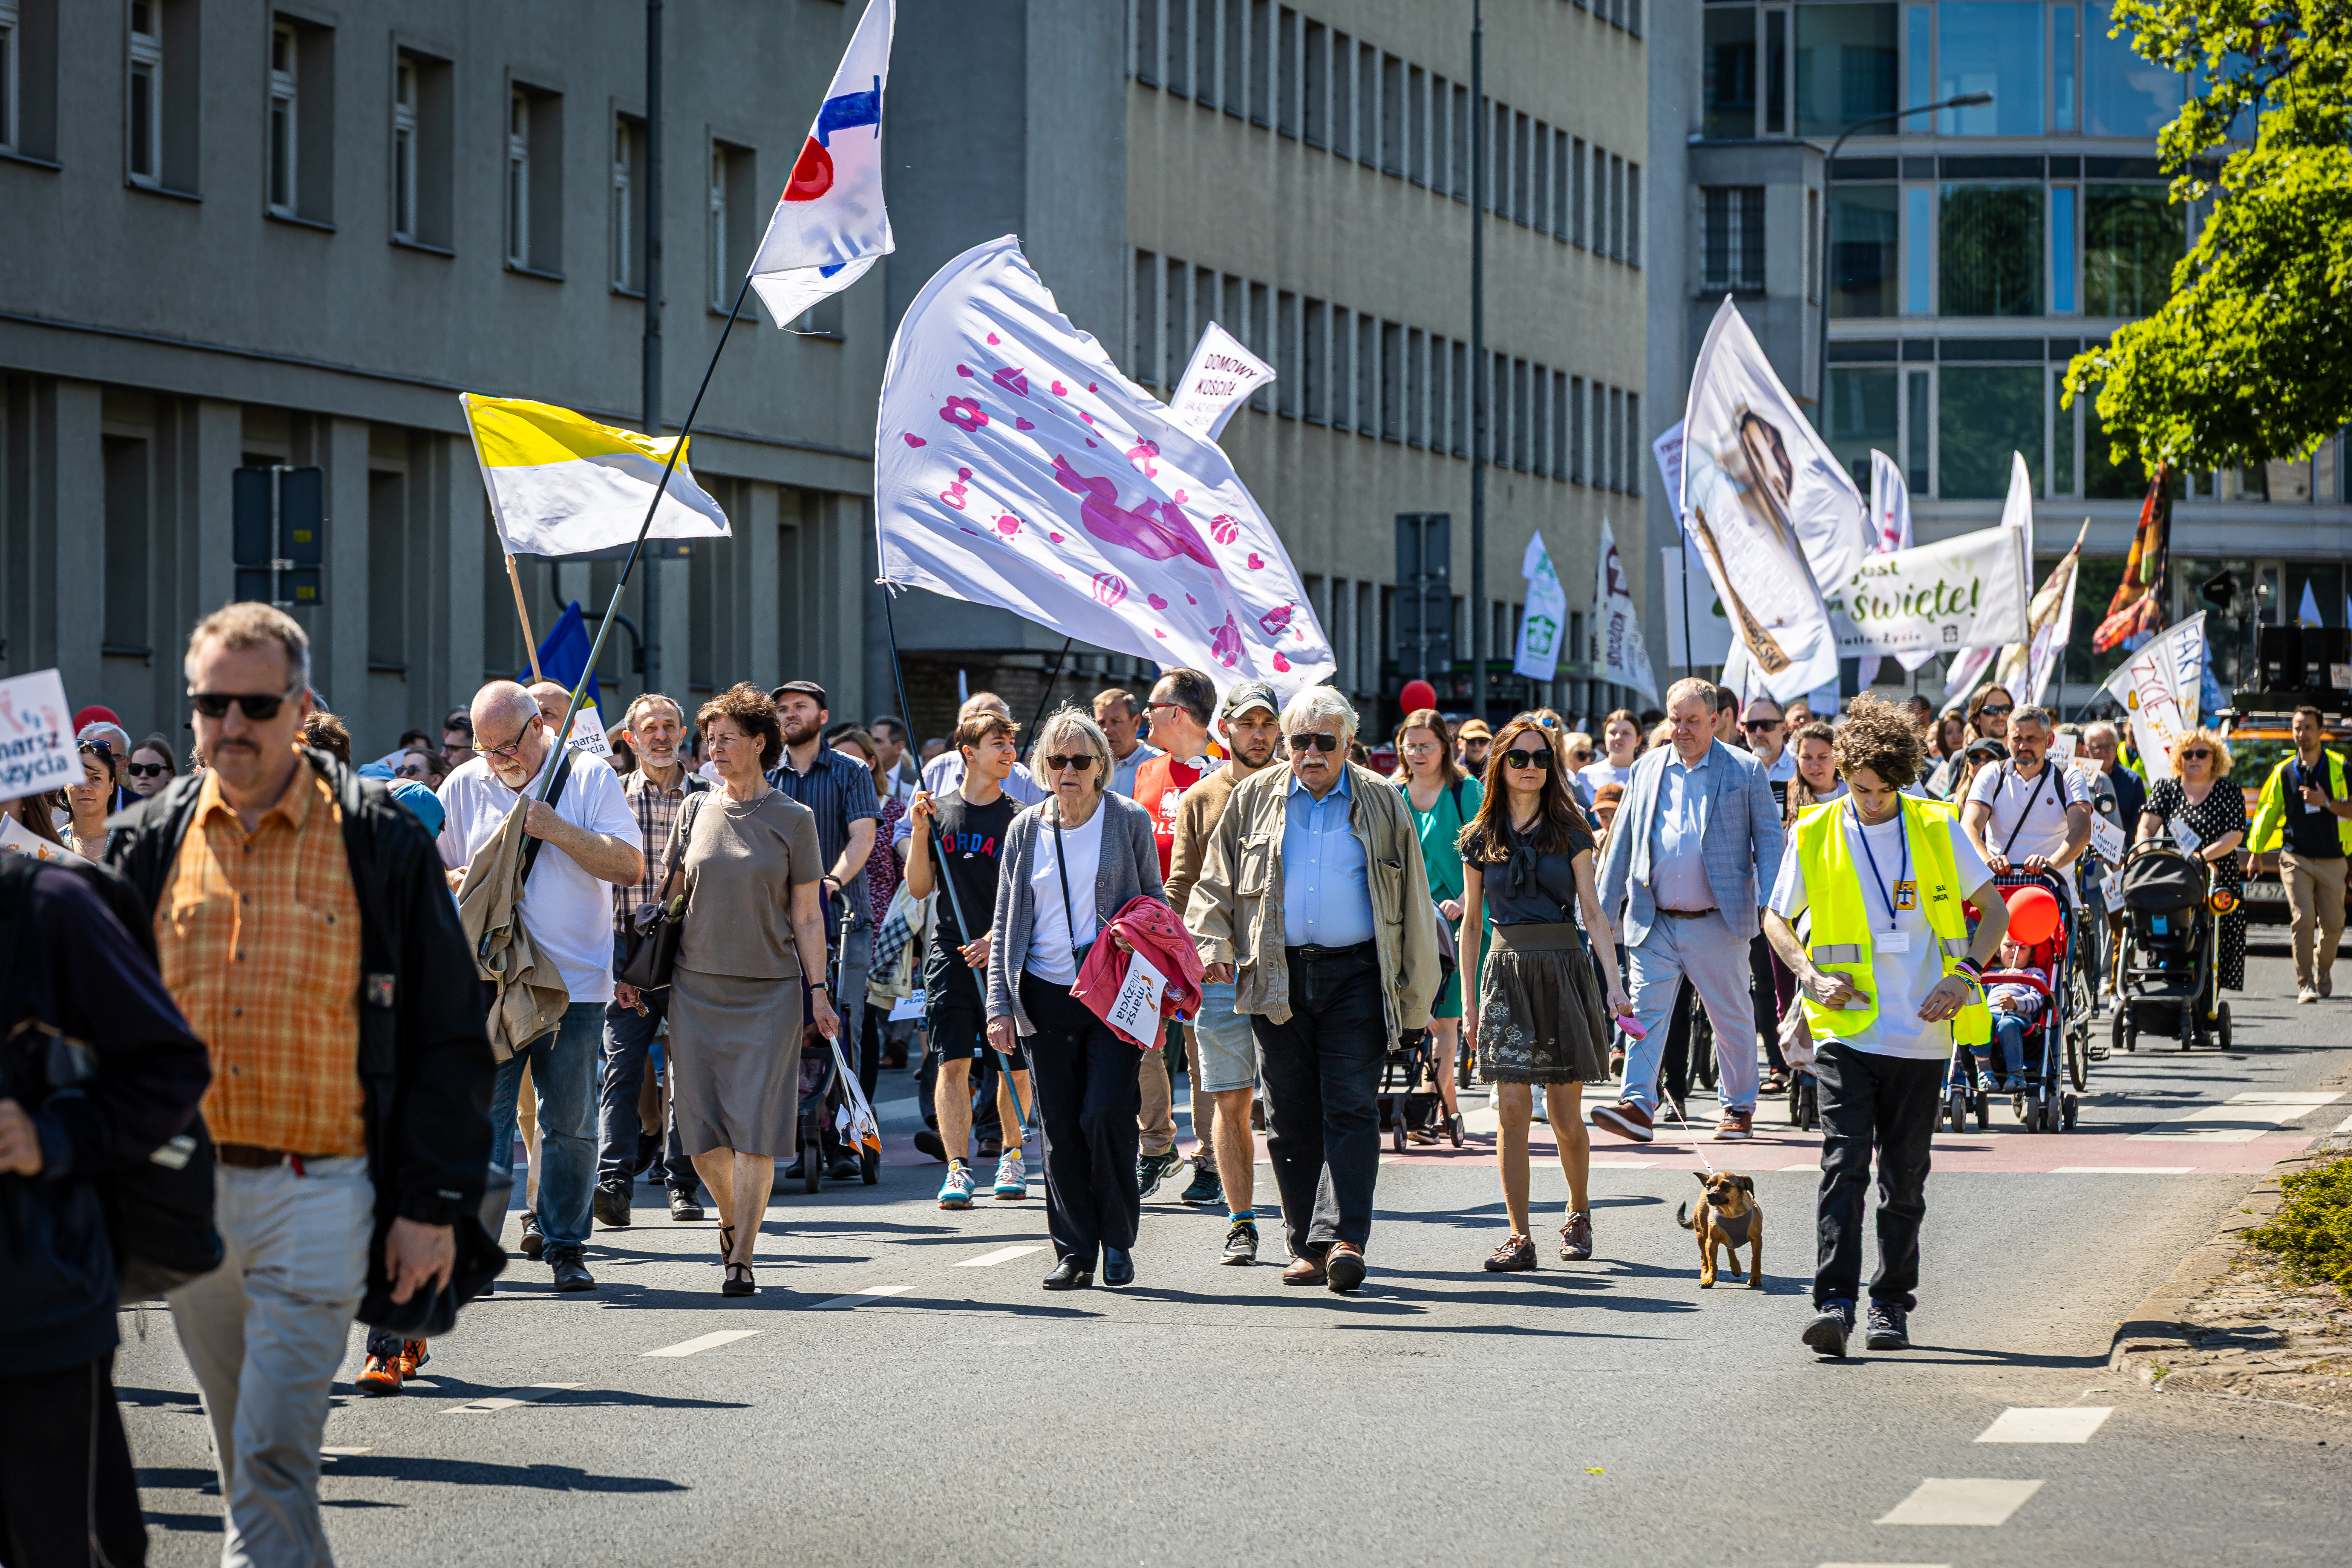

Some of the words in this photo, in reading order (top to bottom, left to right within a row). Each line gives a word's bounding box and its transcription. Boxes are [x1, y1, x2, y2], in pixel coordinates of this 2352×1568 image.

[1204, 354, 1258, 378] DOMOWY
[1851, 576, 1980, 624] święte!
[1150, 821, 1176, 834] OLS
[943, 833, 1004, 862] ORDAN
[2097, 834, 2117, 852] marsz
[1125, 986, 1145, 1026] marsz
